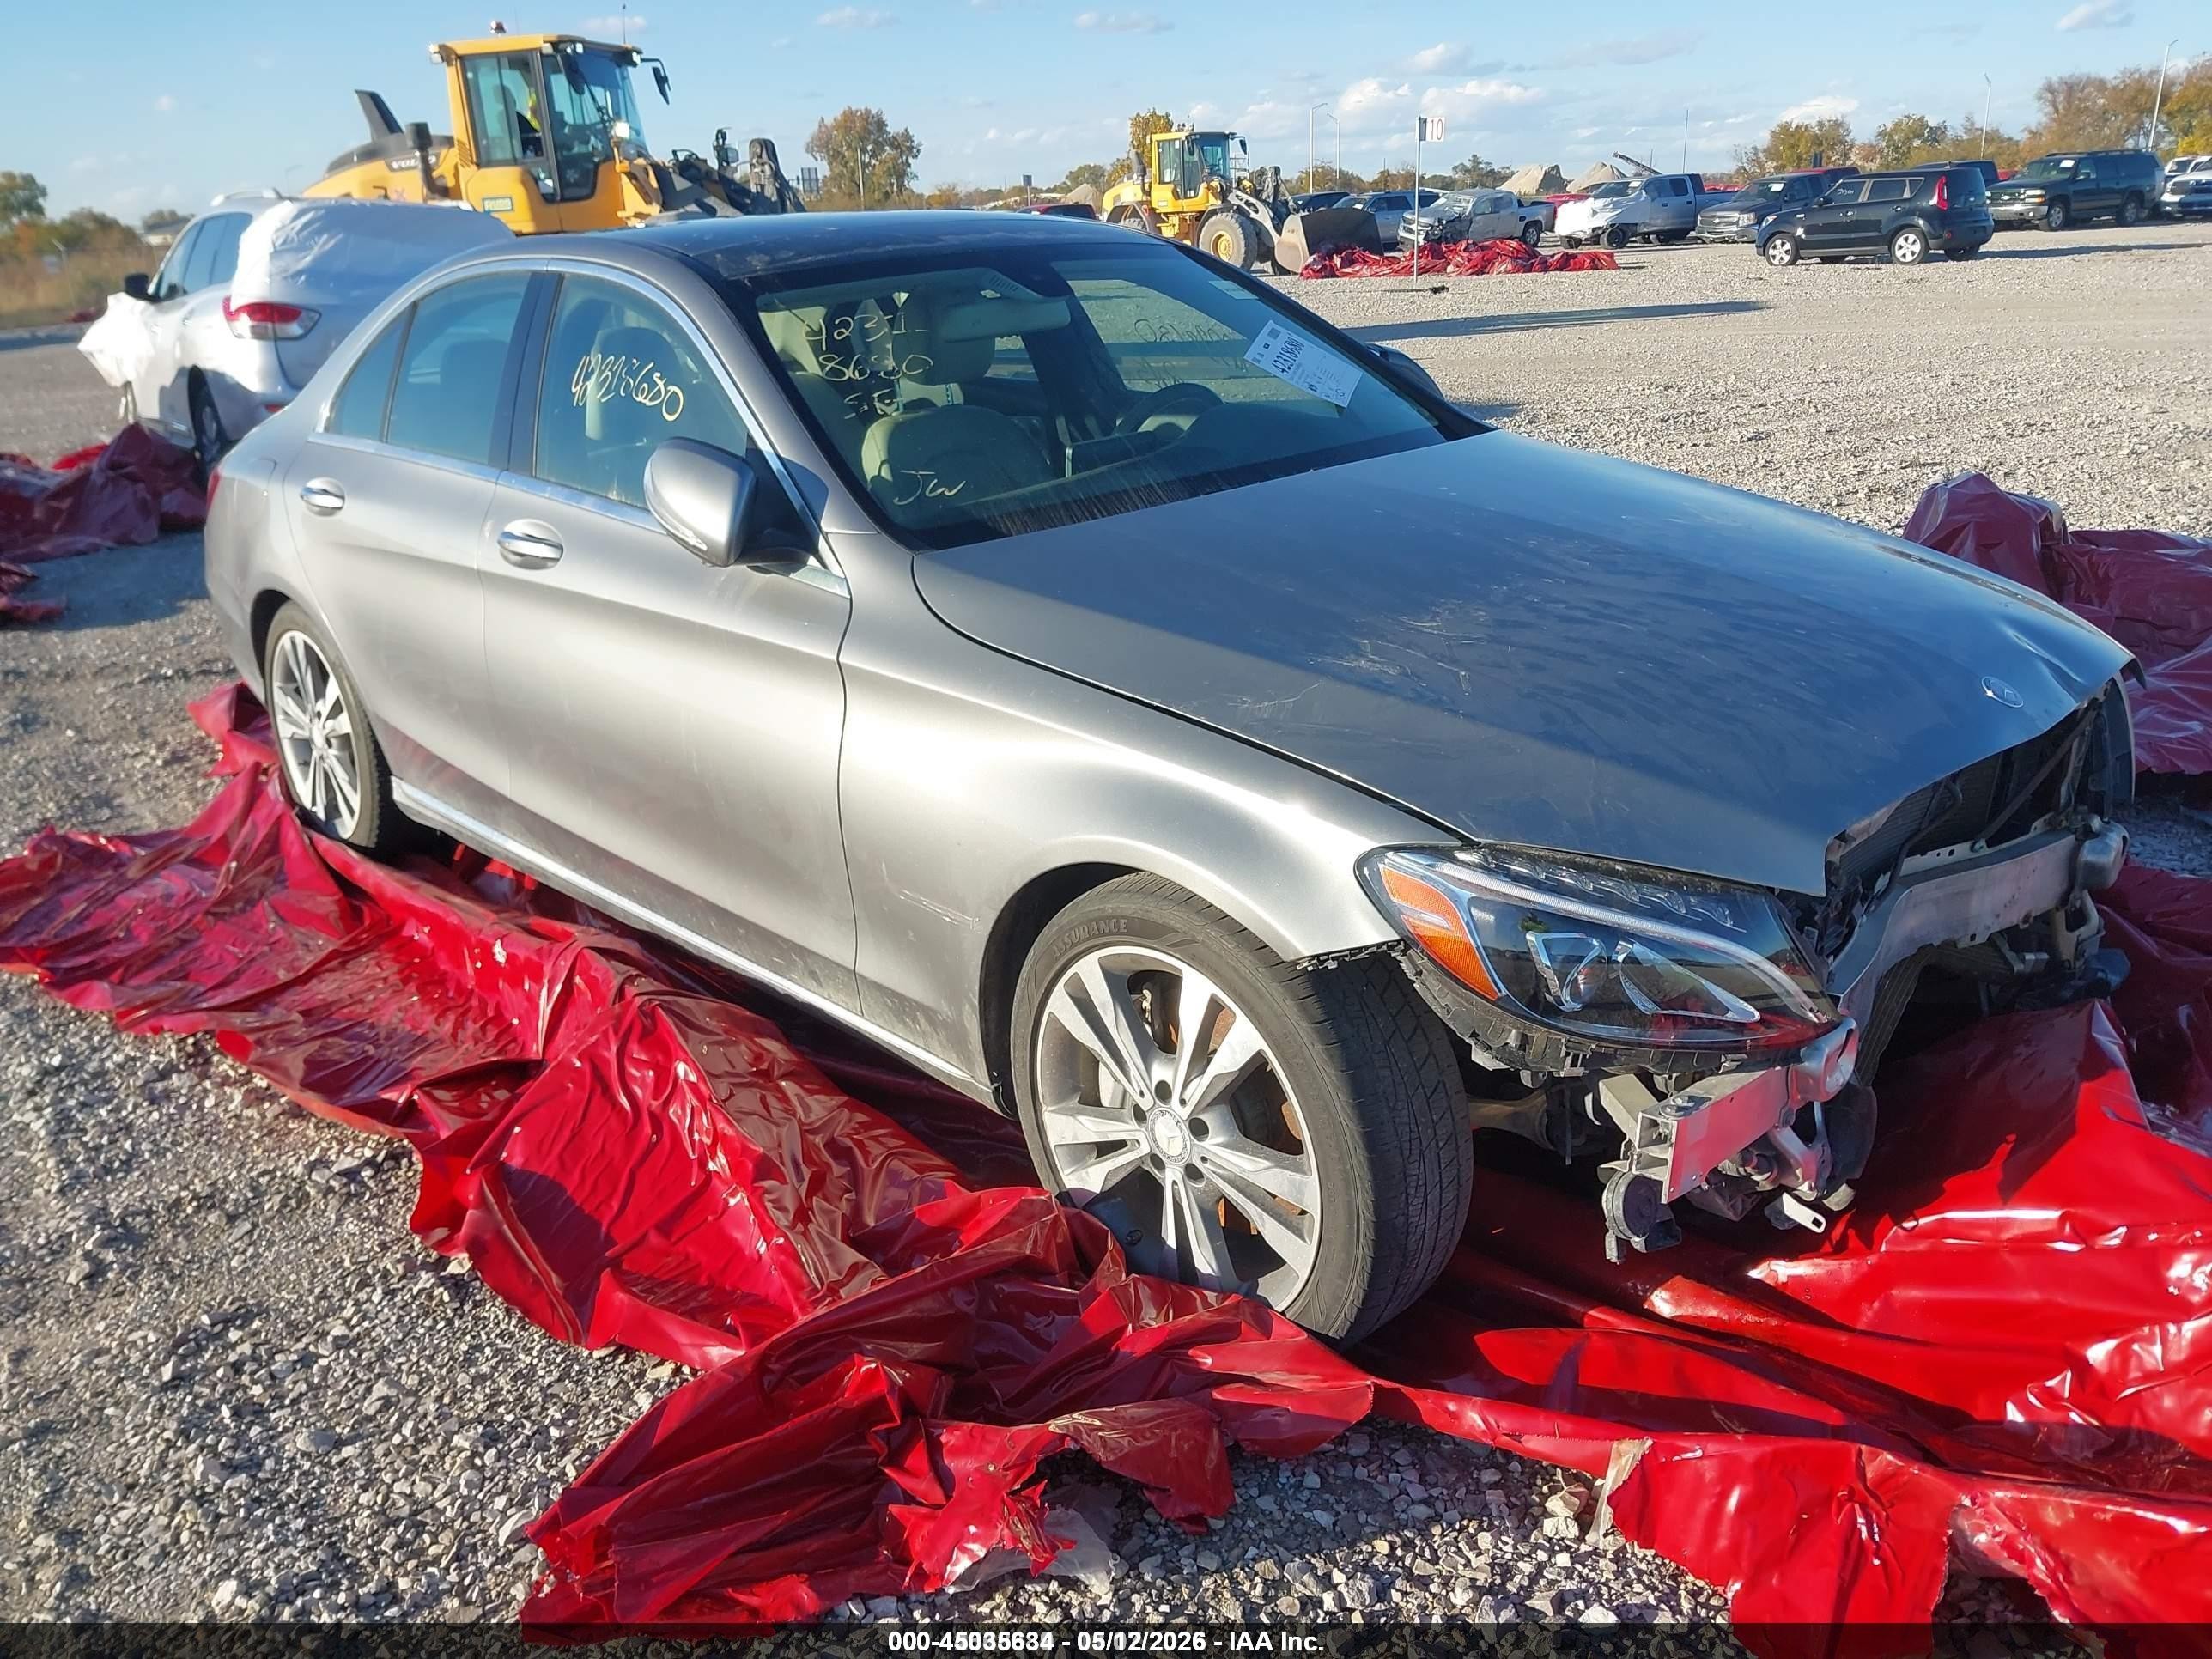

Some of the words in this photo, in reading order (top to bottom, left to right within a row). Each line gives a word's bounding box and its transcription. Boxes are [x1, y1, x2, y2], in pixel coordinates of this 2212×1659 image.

[1430, 118, 1443, 141] 10
[1271, 336, 1305, 374] 42318680
[570, 353, 684, 422] 42318680
